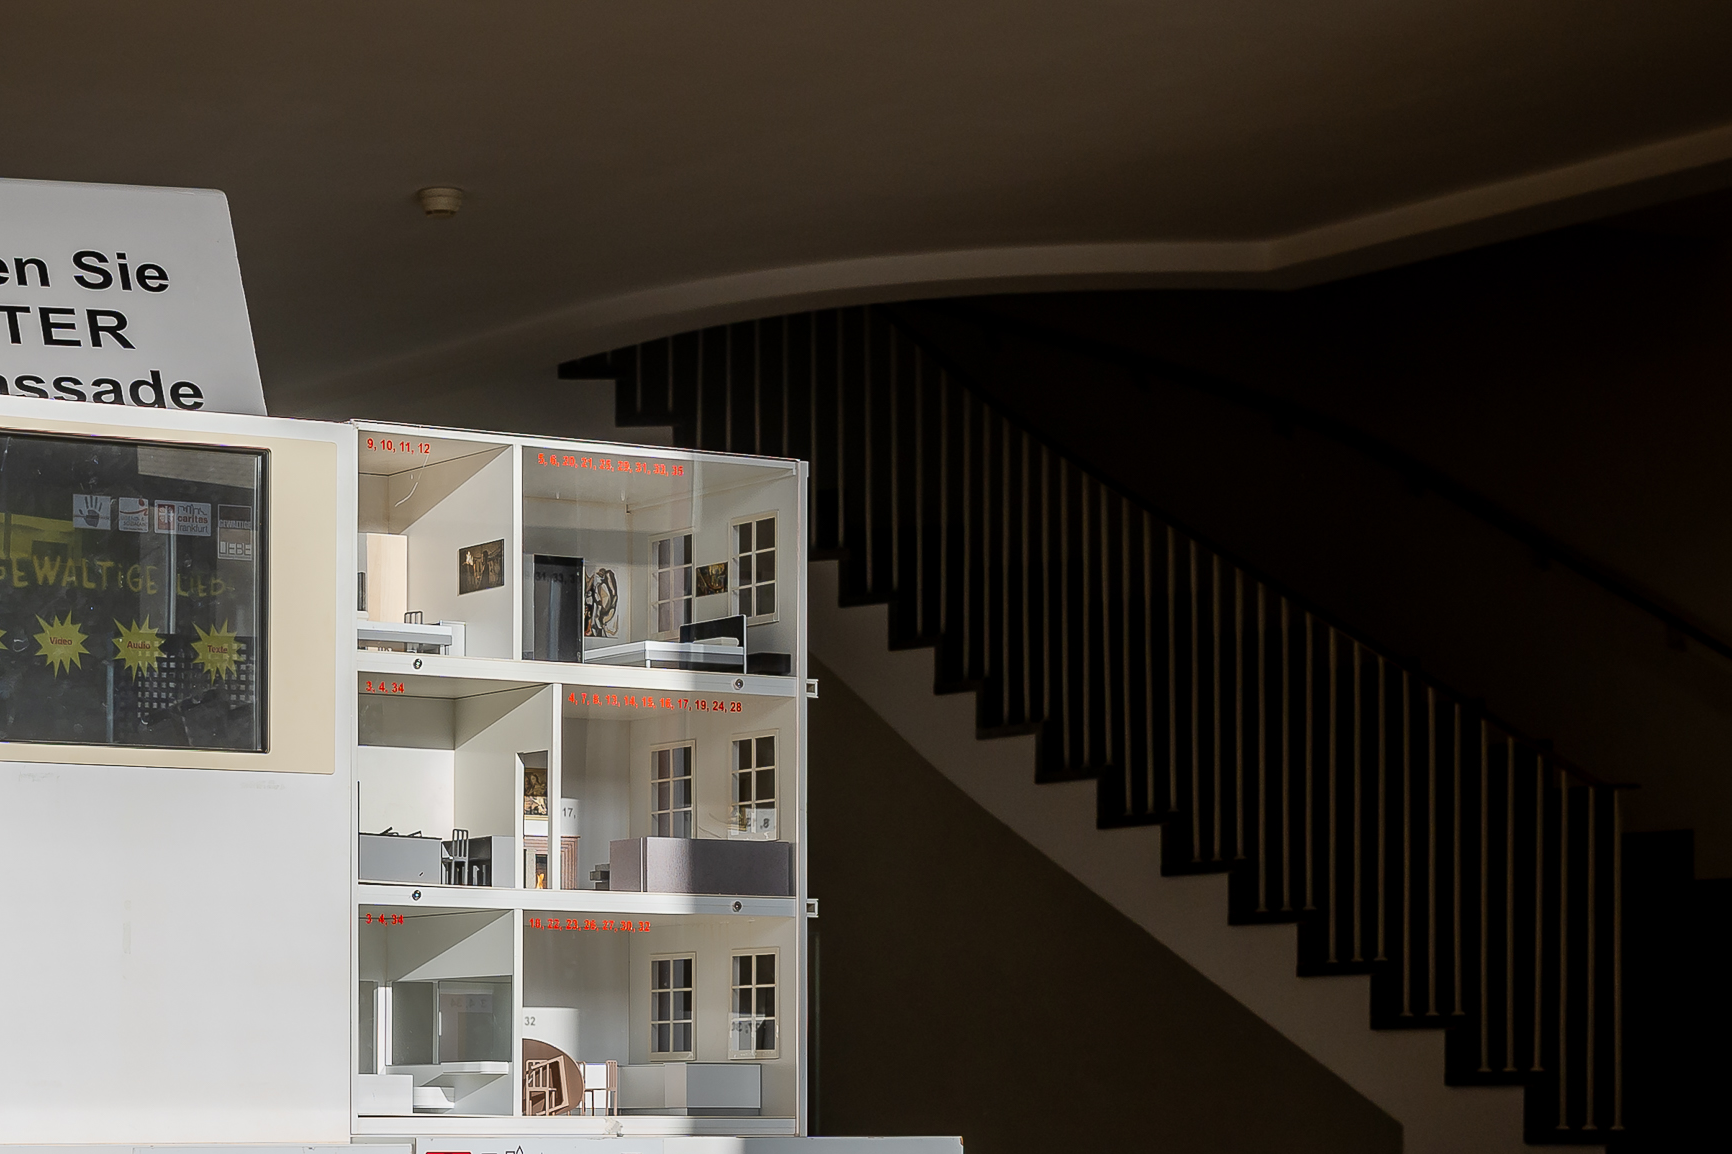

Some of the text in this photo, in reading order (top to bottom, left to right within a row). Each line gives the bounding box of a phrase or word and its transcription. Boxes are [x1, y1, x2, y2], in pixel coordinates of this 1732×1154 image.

[71, 250, 170, 293] Sie
[367, 438, 430, 454] 9, 10, 11, 12
[177, 514, 208, 524] caritas
[177, 523, 208, 533] frankfurt
[49, 637, 72, 645] Video
[127, 641, 150, 650] Audio
[207, 645, 228, 653] Texte
[391, 682, 404, 693] 34
[677, 699, 691, 711] 17,
[695, 700, 710, 712] 19,
[712, 701, 727, 713] 24,
[730, 702, 742, 712] 28
[391, 914, 404, 925] 34
